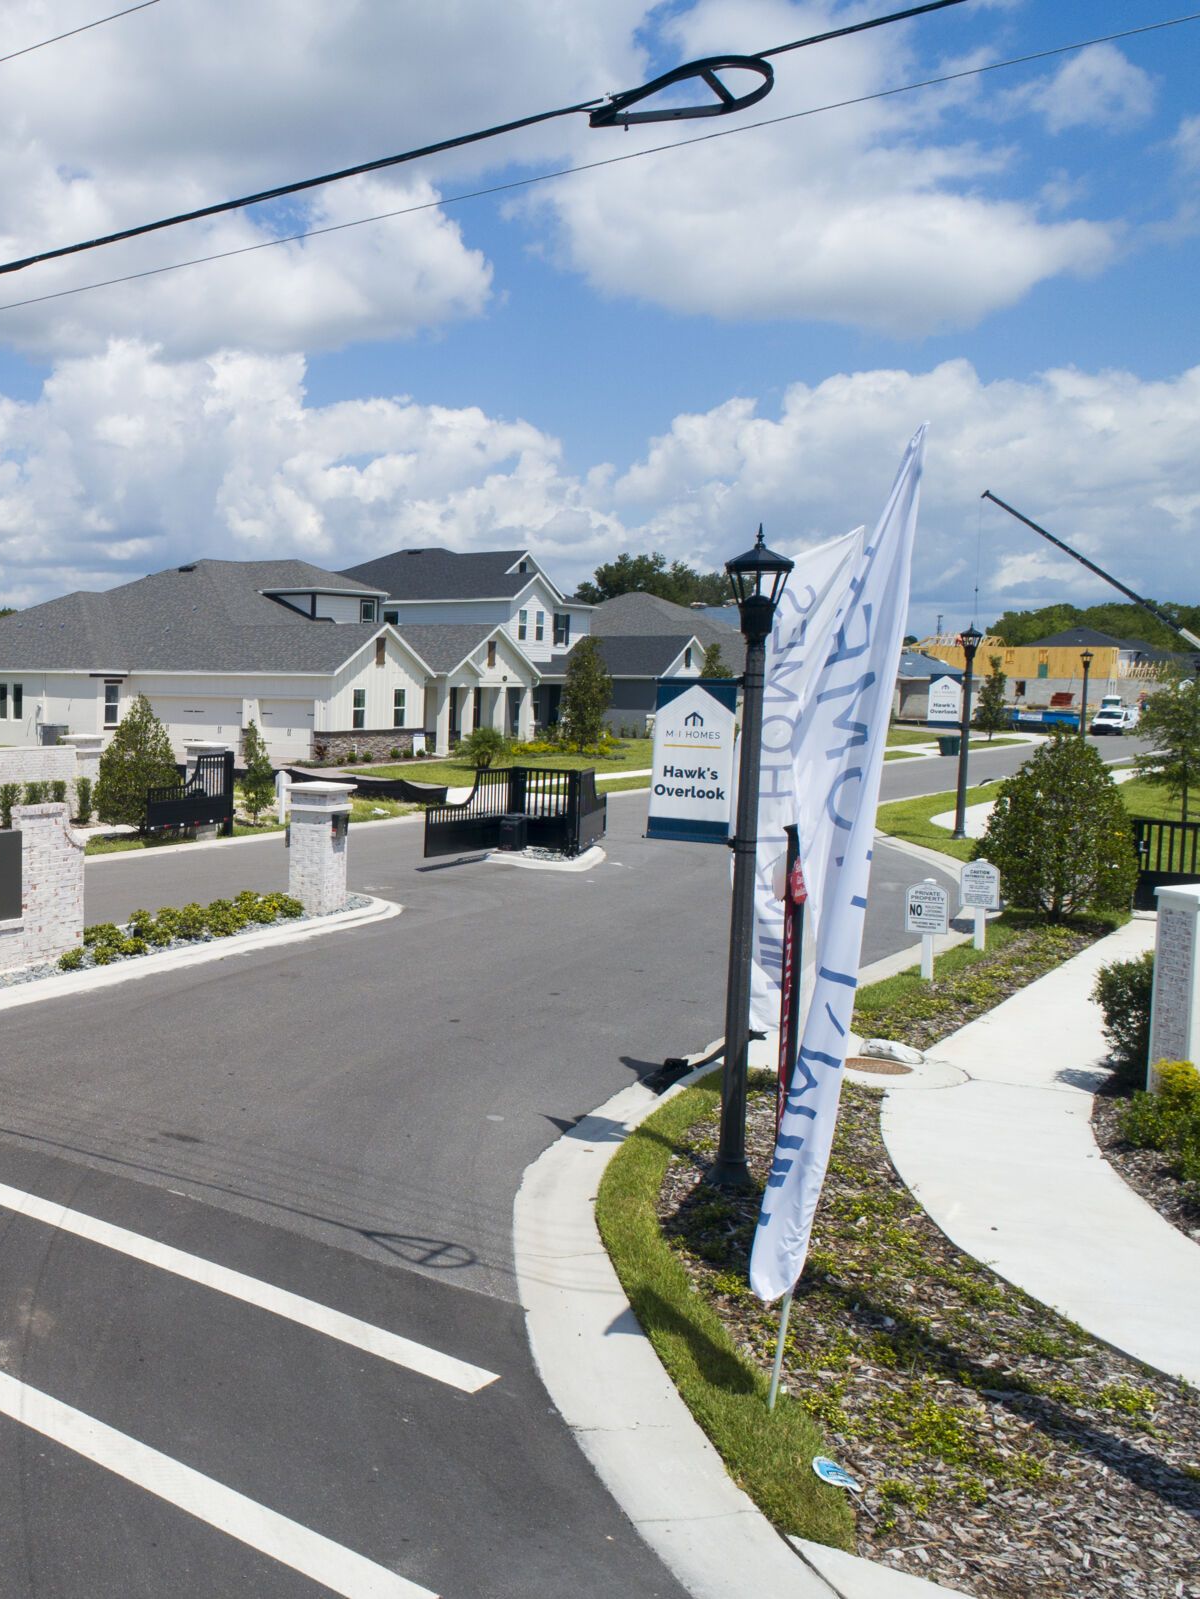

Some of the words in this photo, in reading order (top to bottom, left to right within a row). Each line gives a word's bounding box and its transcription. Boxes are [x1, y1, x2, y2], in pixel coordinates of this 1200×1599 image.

[685, 730, 721, 740] HOMES
[663, 765, 718, 780] Hawk's
[654, 783, 725, 800] Overlook
[909, 903, 923, 917] NO
